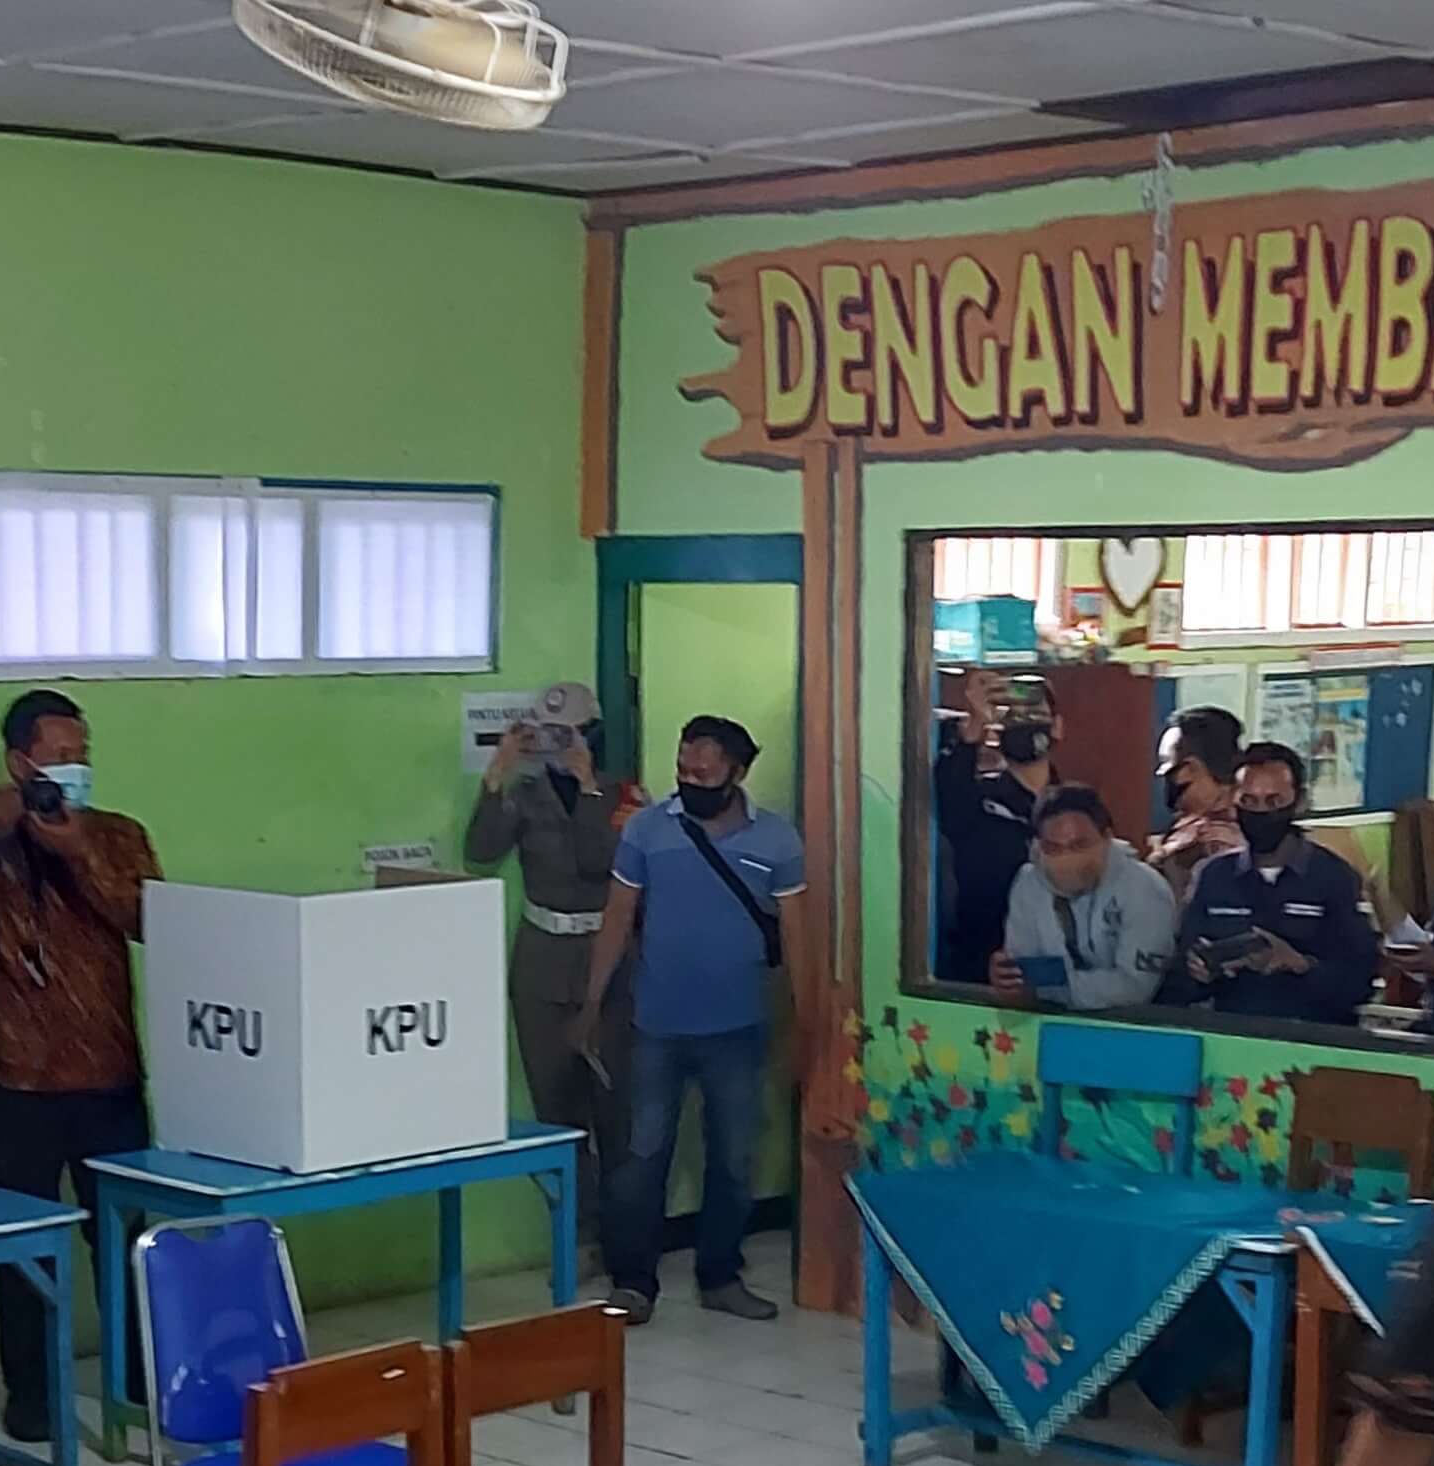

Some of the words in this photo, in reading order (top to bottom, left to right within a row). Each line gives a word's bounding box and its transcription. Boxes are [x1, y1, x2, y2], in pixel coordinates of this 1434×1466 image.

[758, 245, 1145, 440] DENGAN
[186, 999, 263, 1058] KPU
[366, 999, 448, 1056] KPU
